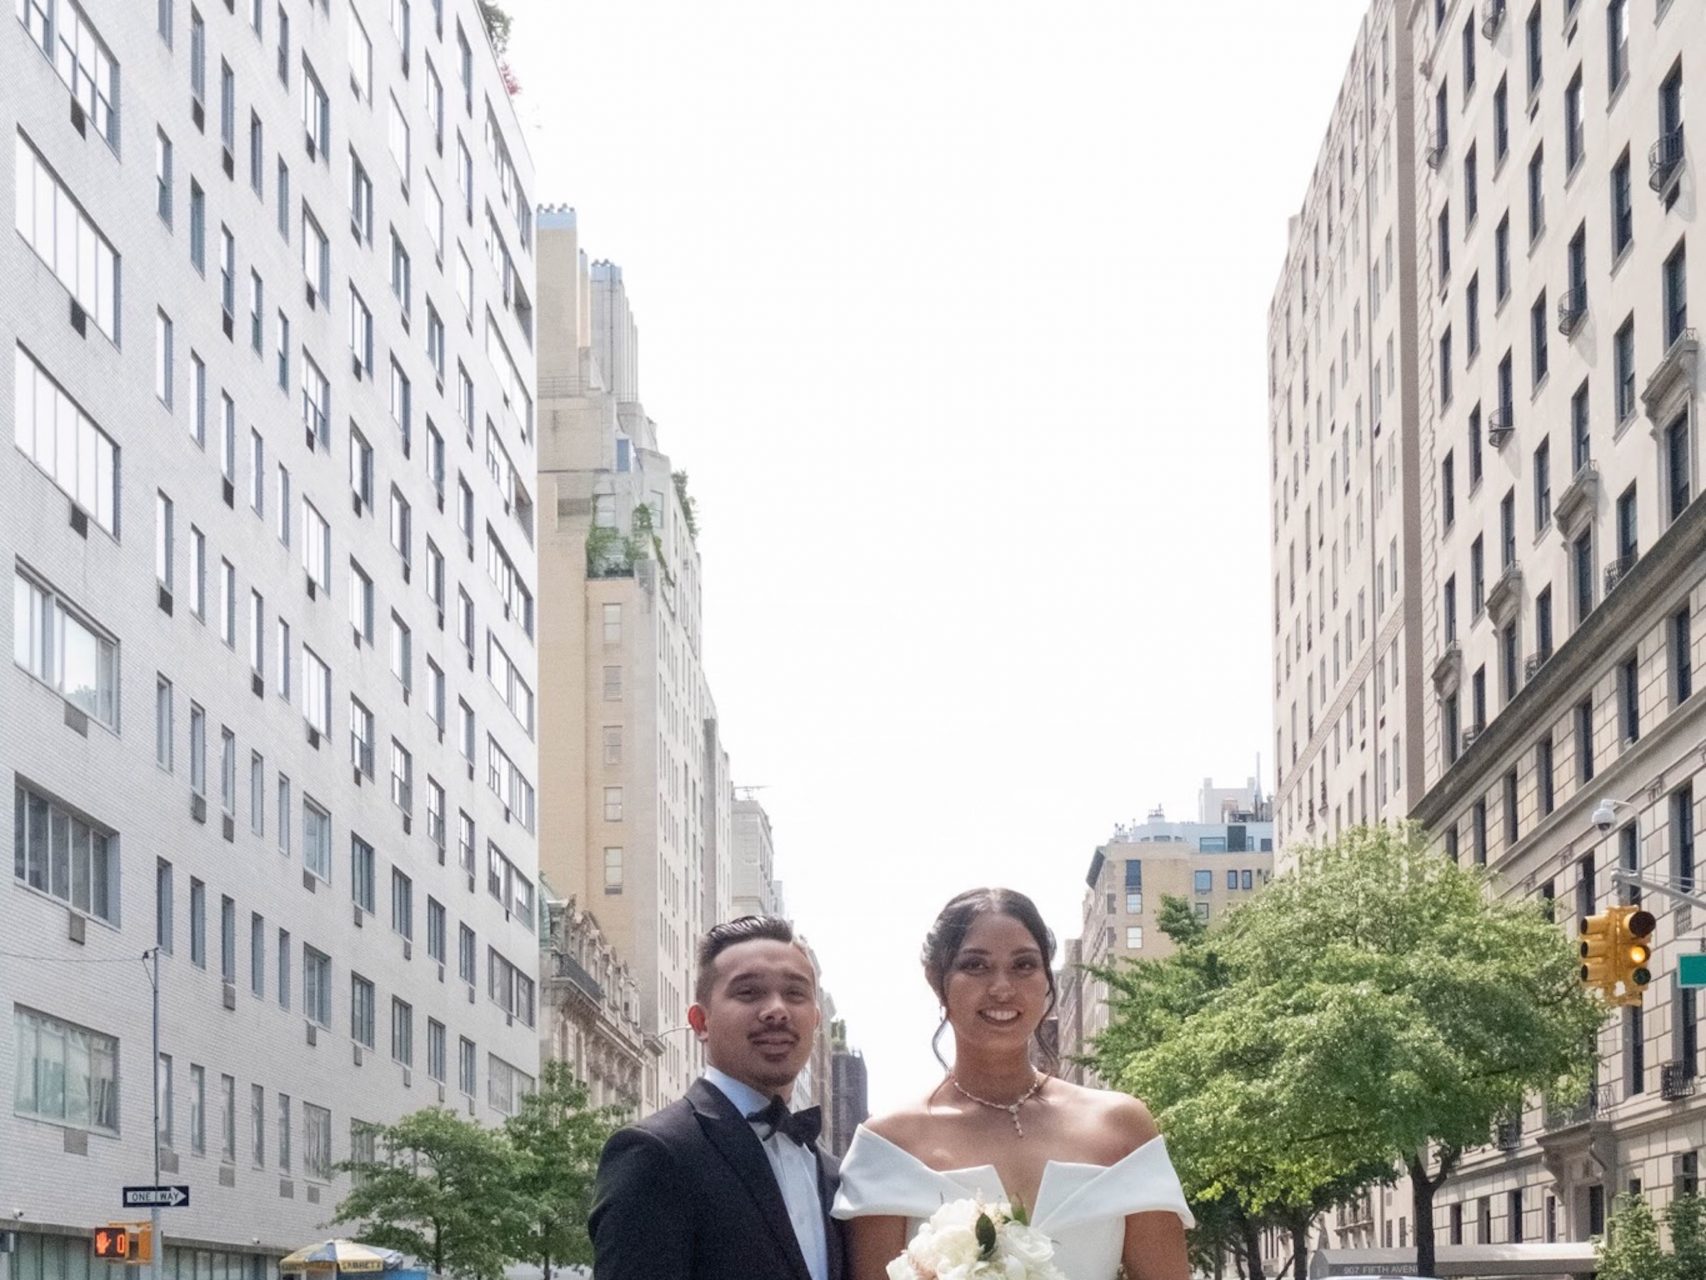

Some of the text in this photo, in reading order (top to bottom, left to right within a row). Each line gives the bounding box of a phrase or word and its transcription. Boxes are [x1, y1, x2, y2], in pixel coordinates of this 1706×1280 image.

[131, 1192, 179, 1202] ONE WAY
[117, 1234, 125, 1254] 0
[1343, 1263, 1419, 1275] 907 FIFTH AVEN
